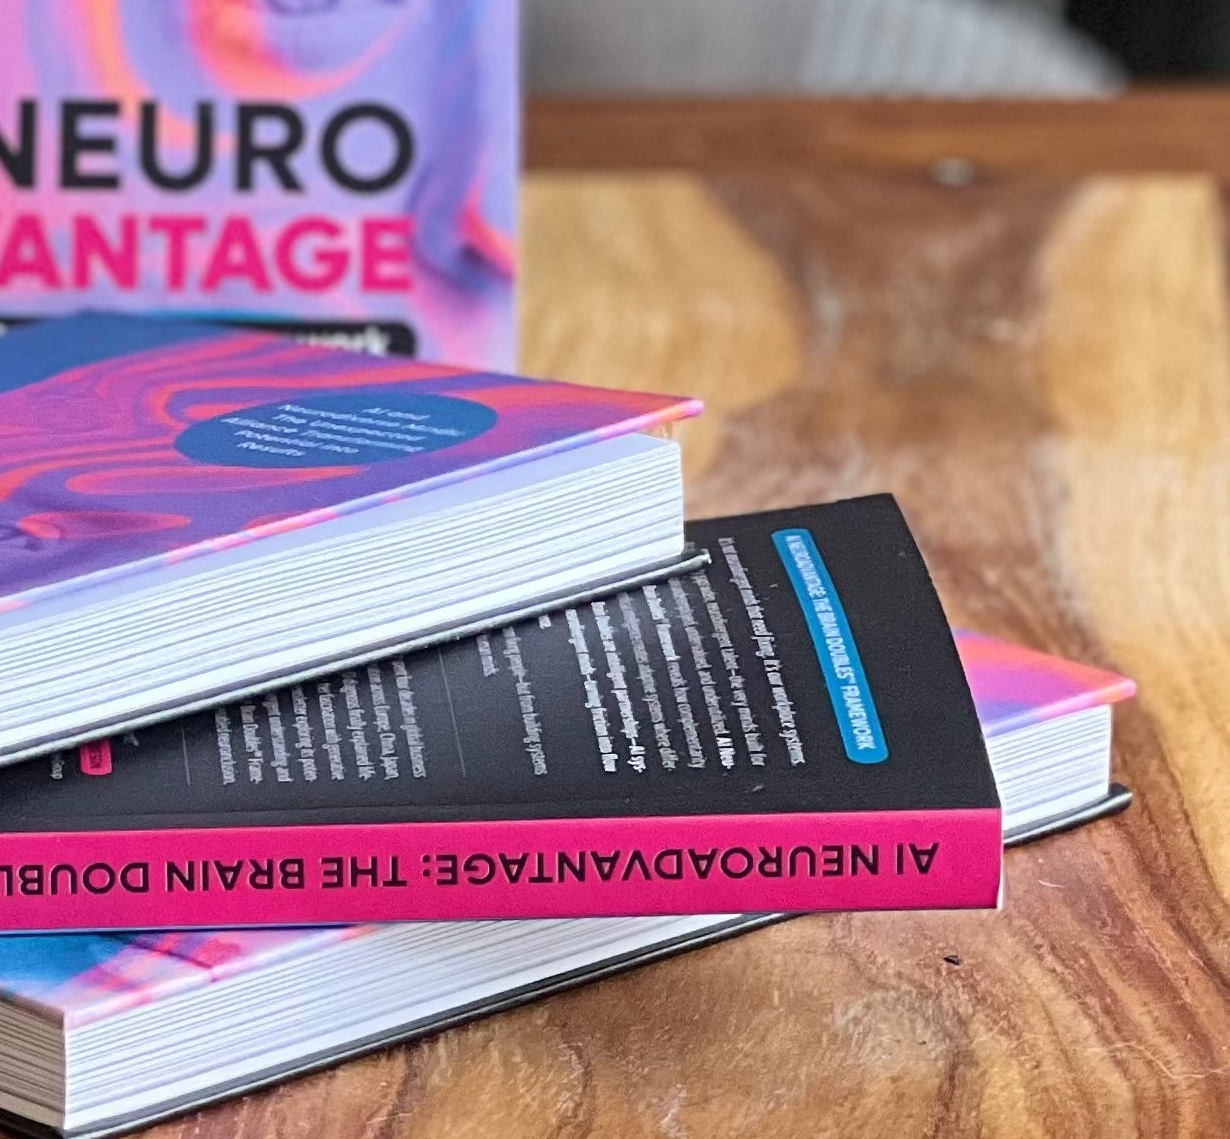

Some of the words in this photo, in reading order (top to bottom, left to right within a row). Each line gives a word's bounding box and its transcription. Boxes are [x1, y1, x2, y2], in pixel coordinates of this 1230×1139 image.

[843, 685, 874, 749] FRAMEWORK
[166, 857, 306, 892] BRAIN
[321, 854, 408, 889] THE
[423, 844, 880, 887] NEUROADVANTAGE:
[896, 842, 941, 876] AI
